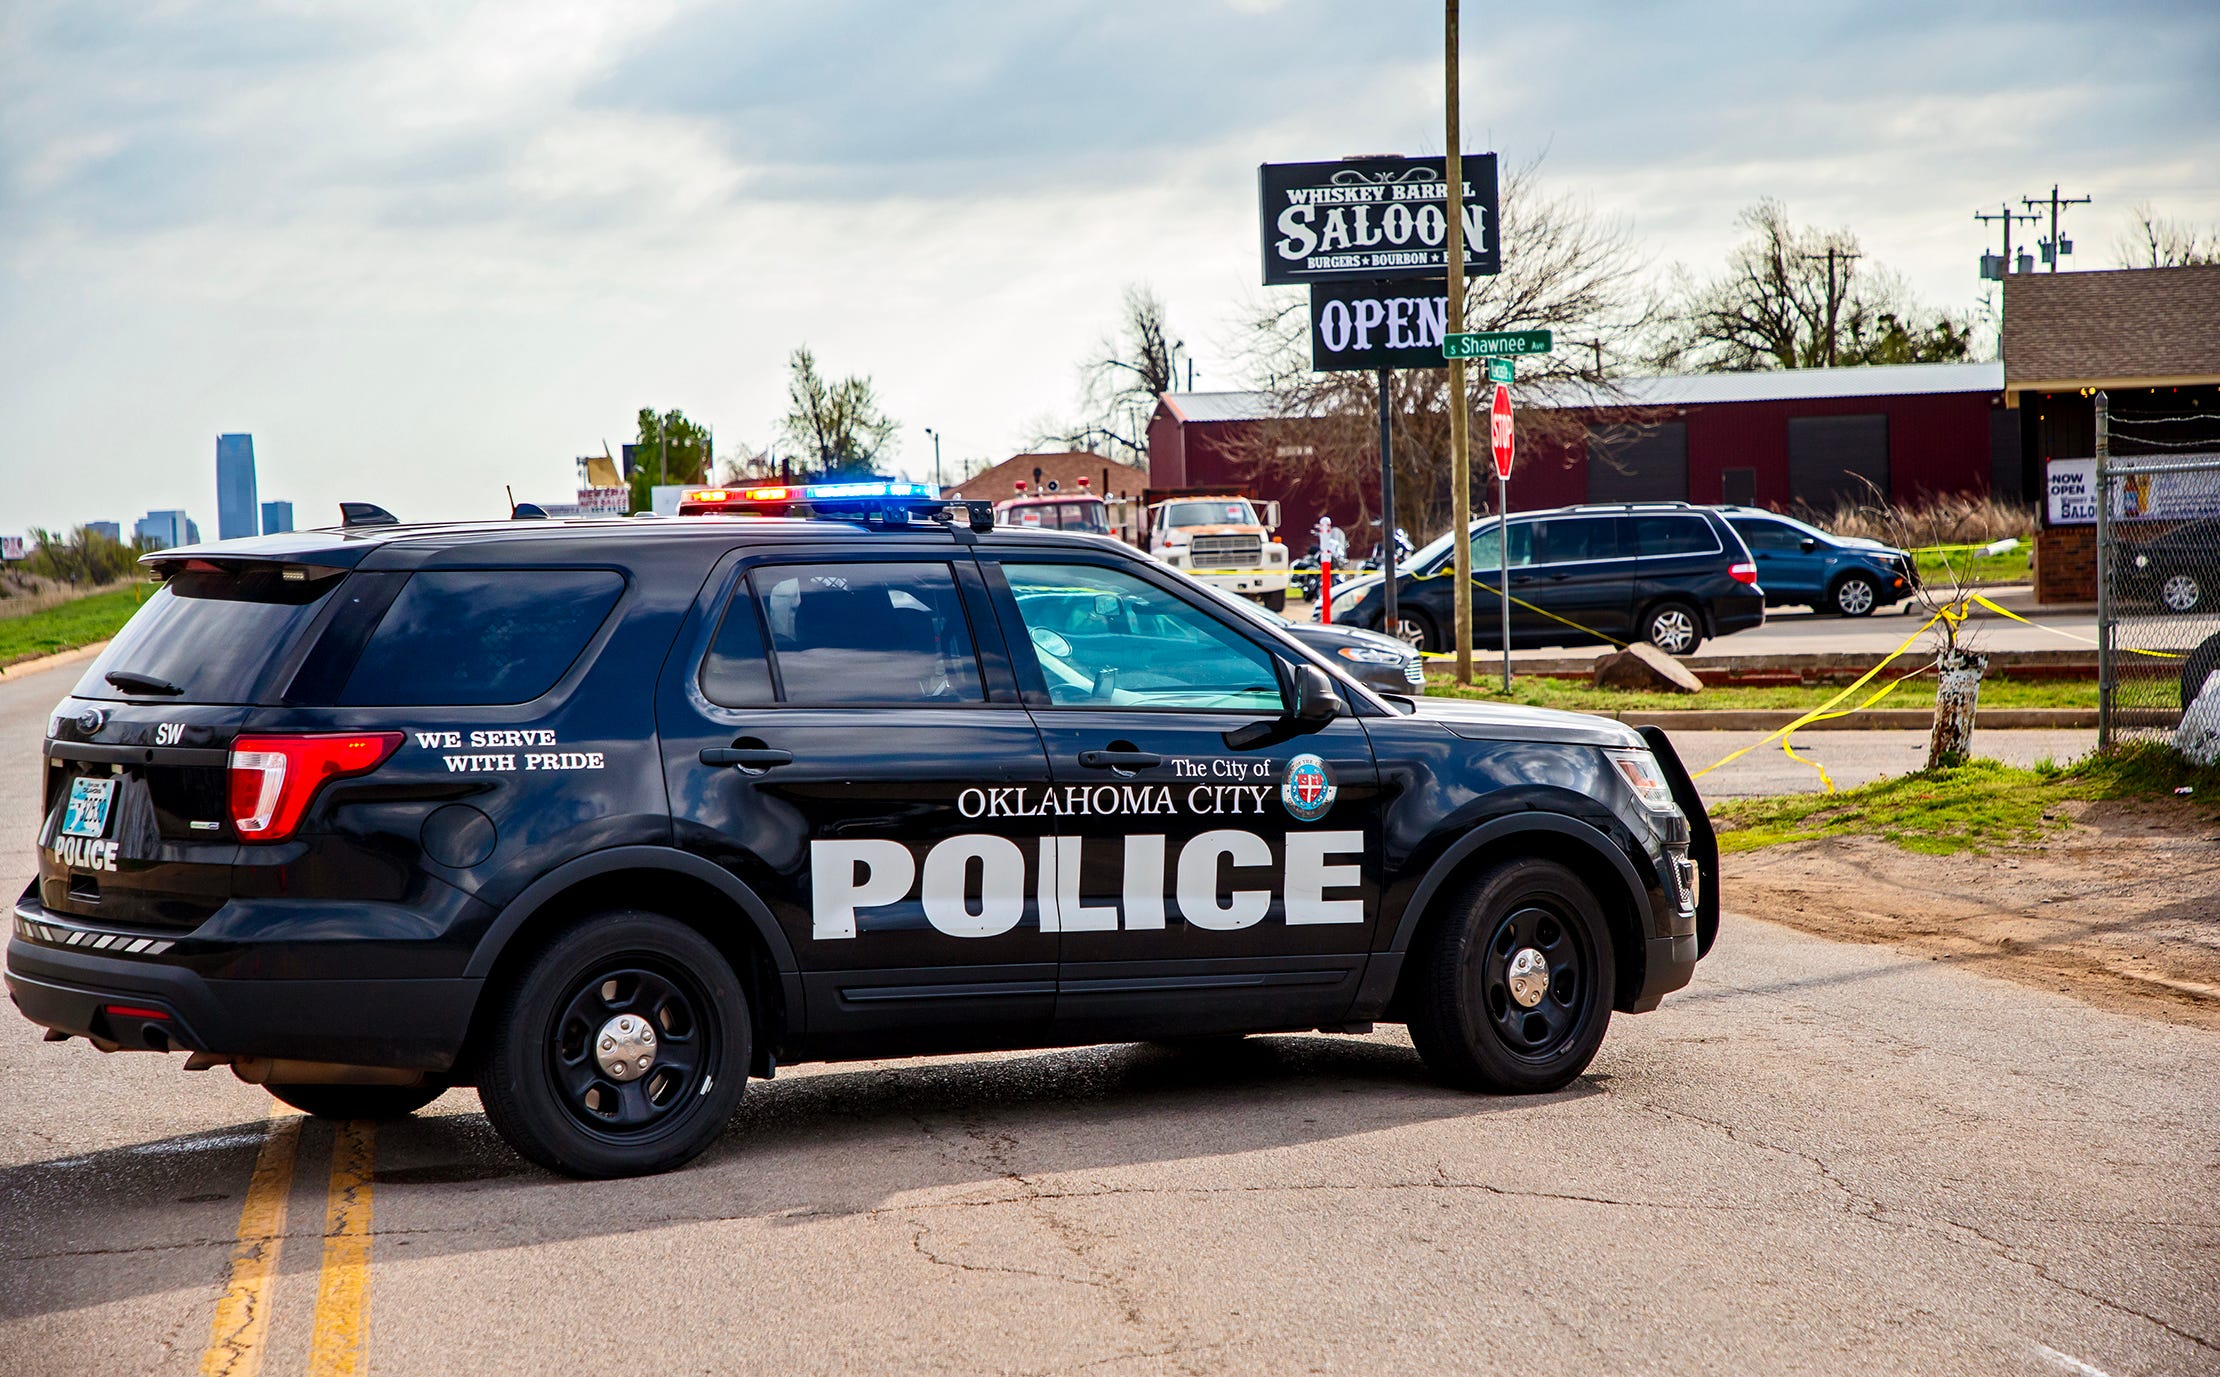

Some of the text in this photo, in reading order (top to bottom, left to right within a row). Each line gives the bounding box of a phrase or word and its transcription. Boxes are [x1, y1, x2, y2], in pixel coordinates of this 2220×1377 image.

[1286, 181, 1476, 204] WHISKEY BARRL
[1275, 202, 1489, 261] SALOON
[1307, 251, 1472, 269] BURGERS BOURBON BR
[1319, 296, 1449, 352] OPEN
[1451, 337, 1545, 355] S Shawnee Ave
[1493, 413, 1512, 449] STOP
[2052, 473, 2083, 484] NOW
[2051, 485, 2085, 495] OPEN
[2061, 503, 2112, 519] SALO
[155, 723, 186, 745] SW
[415, 729, 557, 749] WE SERVE
[443, 752, 605, 772] WITH PRIDE
[1171, 759, 1206, 777] The
[1212, 759, 1249, 781] City
[1253, 758, 1271, 777] of
[957, 785, 1178, 818] OKLAHOMA
[1187, 784, 1274, 815] CITY
[54, 835, 120, 872] POLICE
[810, 828, 1365, 940] POLICE
